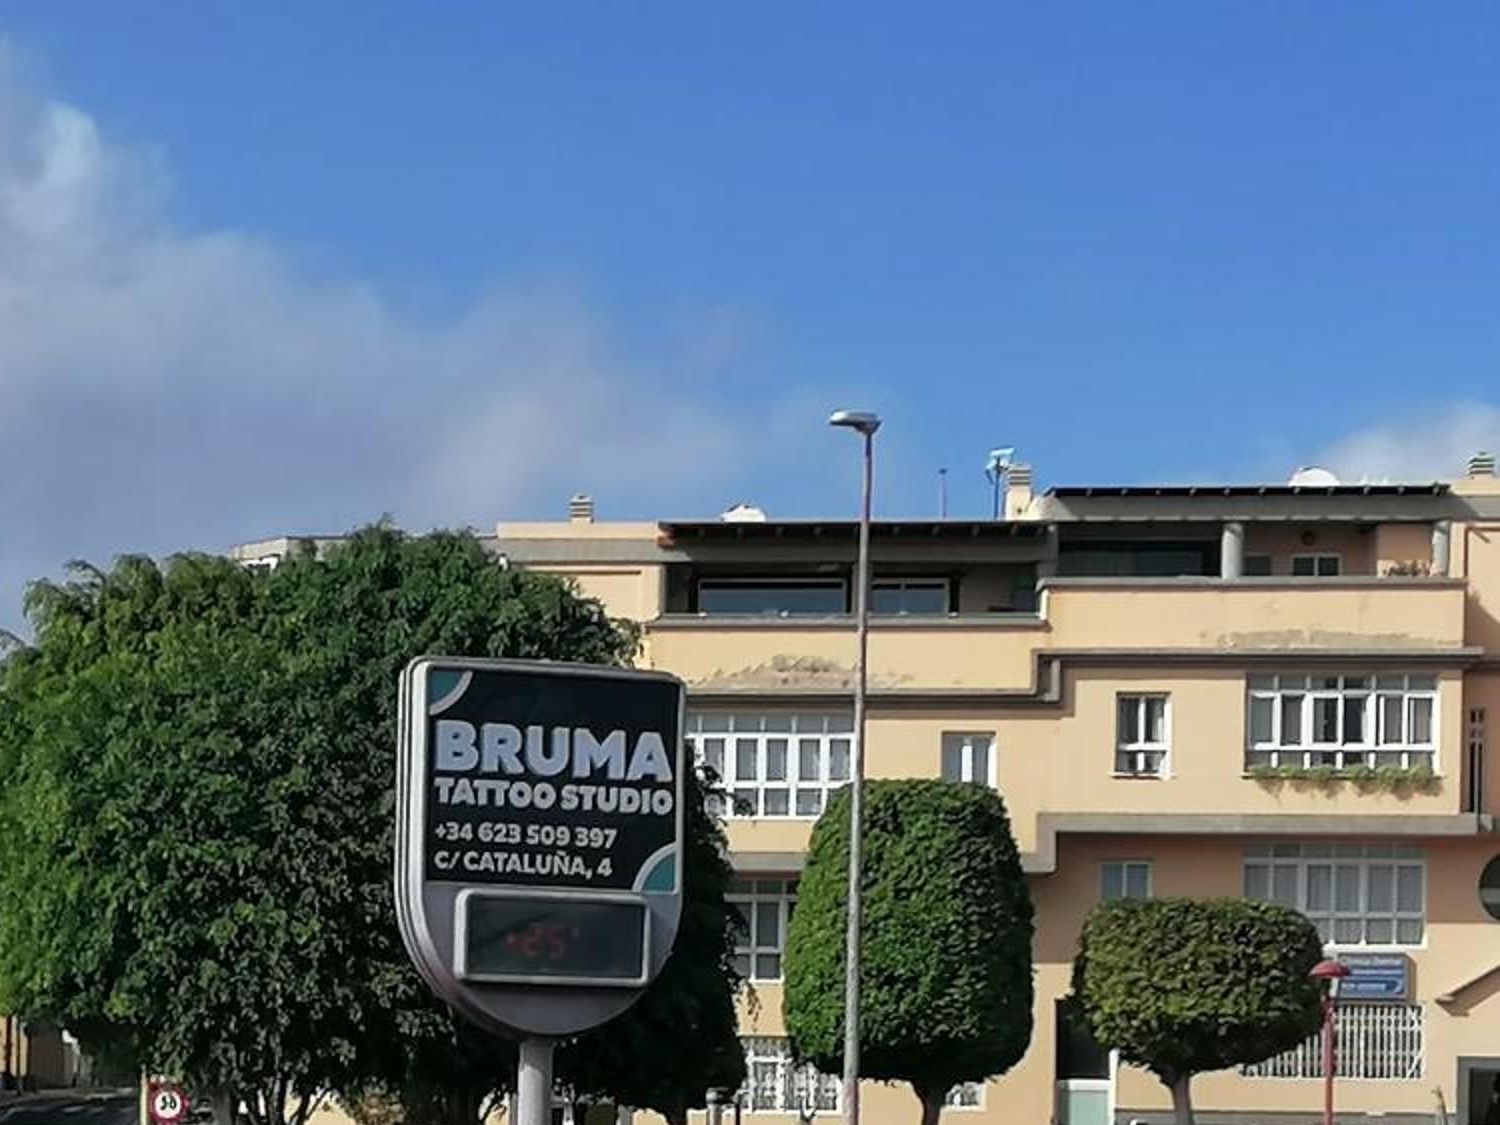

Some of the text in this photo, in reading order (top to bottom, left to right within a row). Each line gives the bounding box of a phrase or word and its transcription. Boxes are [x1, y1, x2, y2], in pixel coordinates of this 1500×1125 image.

[435, 720, 673, 783] BRUMA
[435, 778, 673, 815] TATTOO STUDIO
[435, 822, 617, 848] +34 623 509 397
[435, 850, 612, 879] C/ CATALUÑA, 4
